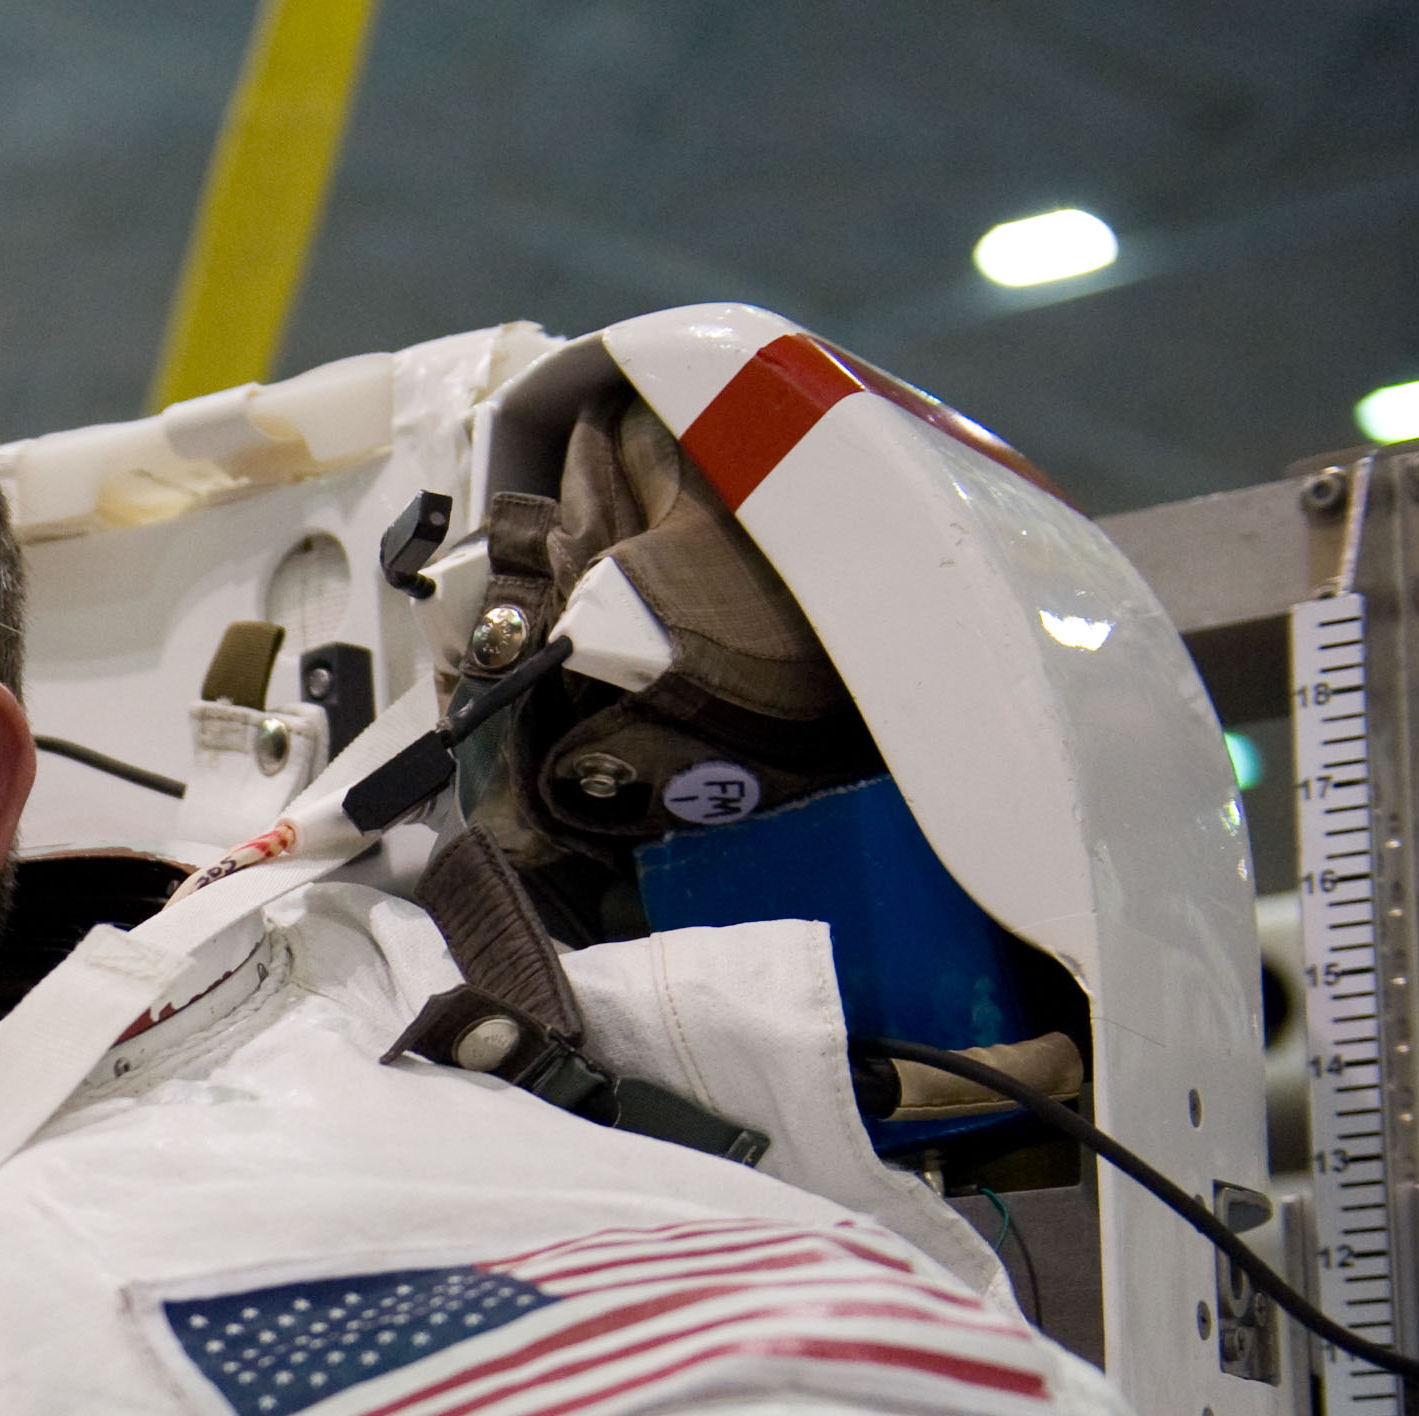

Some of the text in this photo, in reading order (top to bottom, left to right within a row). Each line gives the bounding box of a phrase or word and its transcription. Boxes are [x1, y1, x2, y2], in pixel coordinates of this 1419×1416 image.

[1296, 682, 1332, 708] 18
[705, 781, 745, 818] FM
[1299, 775, 1333, 800] 17
[1302, 869, 1338, 894] 16
[1305, 962, 1340, 987] 15
[1309, 1053, 1344, 1078] 14
[1314, 1148, 1350, 1174] 13
[1317, 1244, 1354, 1269] 12
